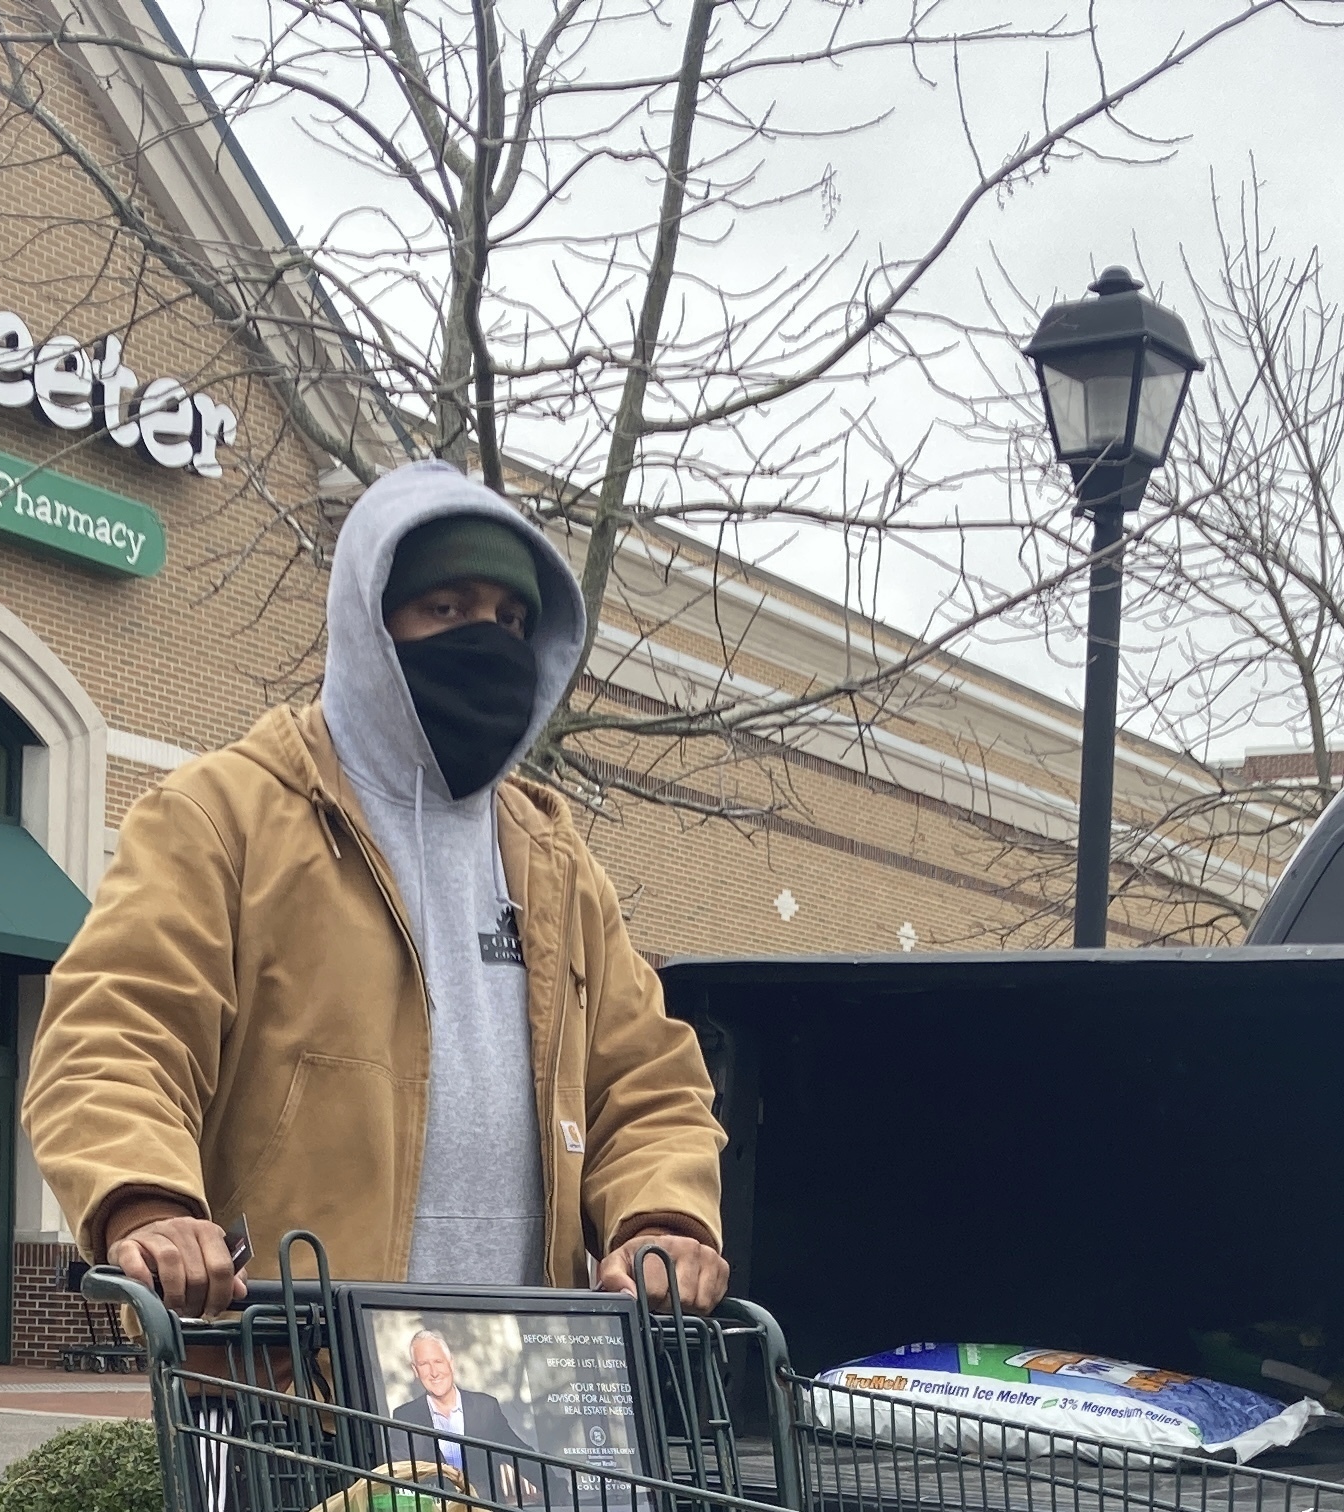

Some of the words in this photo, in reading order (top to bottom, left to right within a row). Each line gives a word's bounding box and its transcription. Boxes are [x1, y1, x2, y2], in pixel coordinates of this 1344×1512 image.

[522, 1334, 553, 1344] BEFORE
[554, 1334, 567, 1344] WE
[591, 1336, 604, 1345] WE
[546, 1358, 576, 1368] BEFORE
[570, 1382, 594, 1392] YOUR
[596, 1383, 632, 1393] TRUSTED
[547, 1394, 581, 1403] ADVISOR
[581, 1394, 598, 1403] FOR
[599, 1394, 611, 1404] ALL
[611, 1394, 634, 1404] YOUR
[845, 1374, 909, 1391] TruMelt
[909, 1379, 970, 1399] Premium
[972, 1385, 994, 1401] Ice
[996, 1390, 1042, 1407] Melter
[1058, 1398, 1078, 1411] 3%
[1080, 1401, 1143, 1419] Magnesium
[1144, 1409, 1183, 1427] Pellets
[564, 1405, 582, 1415] REAL
[583, 1406, 607, 1415] ESTATE
